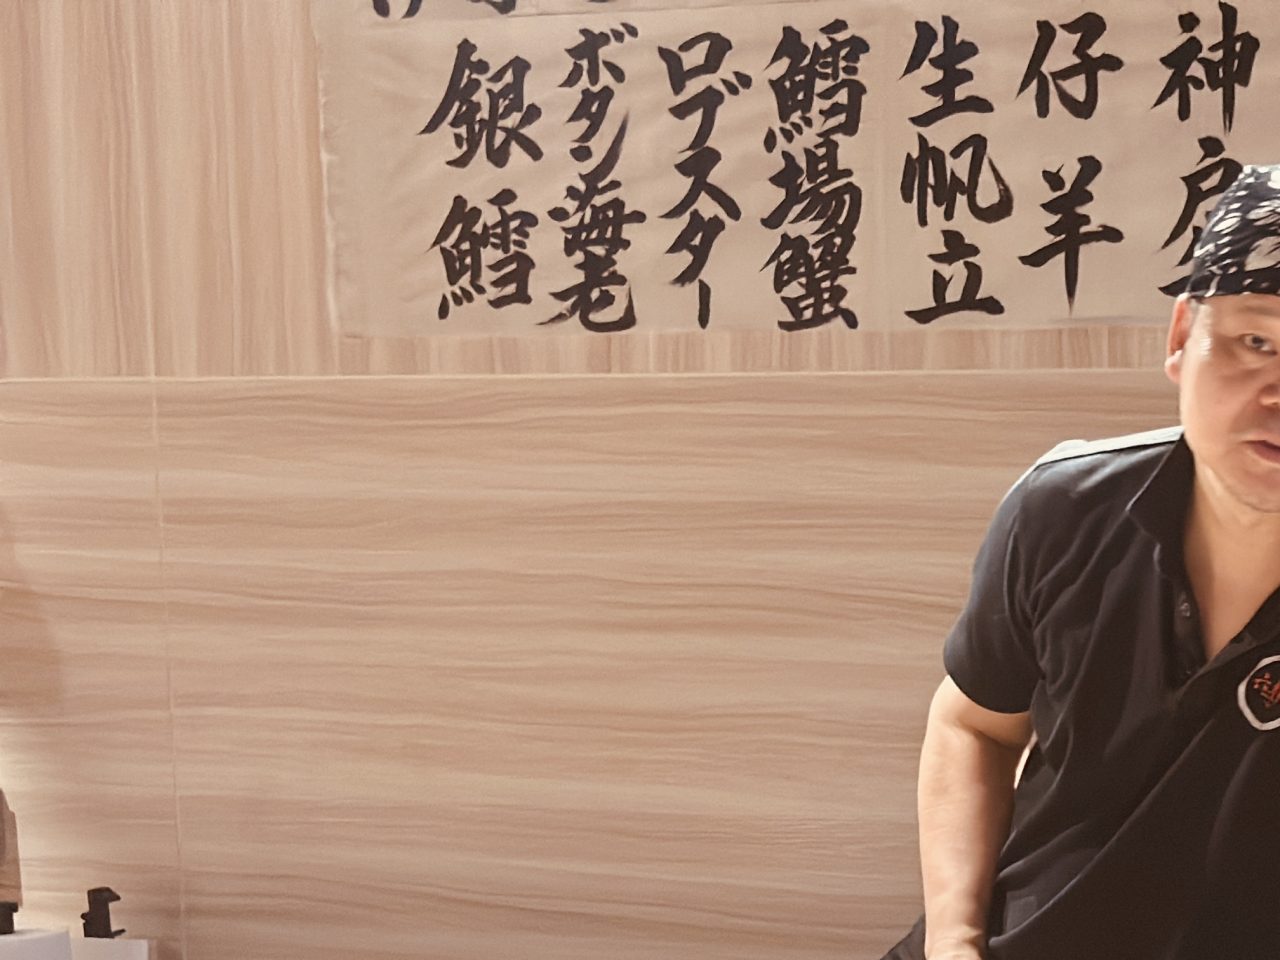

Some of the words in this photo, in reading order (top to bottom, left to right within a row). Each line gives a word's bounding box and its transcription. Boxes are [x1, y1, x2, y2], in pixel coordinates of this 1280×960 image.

[417, 38, 544, 321] 銀鱈
[537, 22, 648, 333] ボタン海老
[658, 31, 753, 330] ロブスター
[760, 18, 871, 333] 鱈場蟹
[899, 14, 1014, 325] 生帆立
[1015, 11, 1125, 316] 仔羊
[1150, 1, 1262, 298] 神戸
